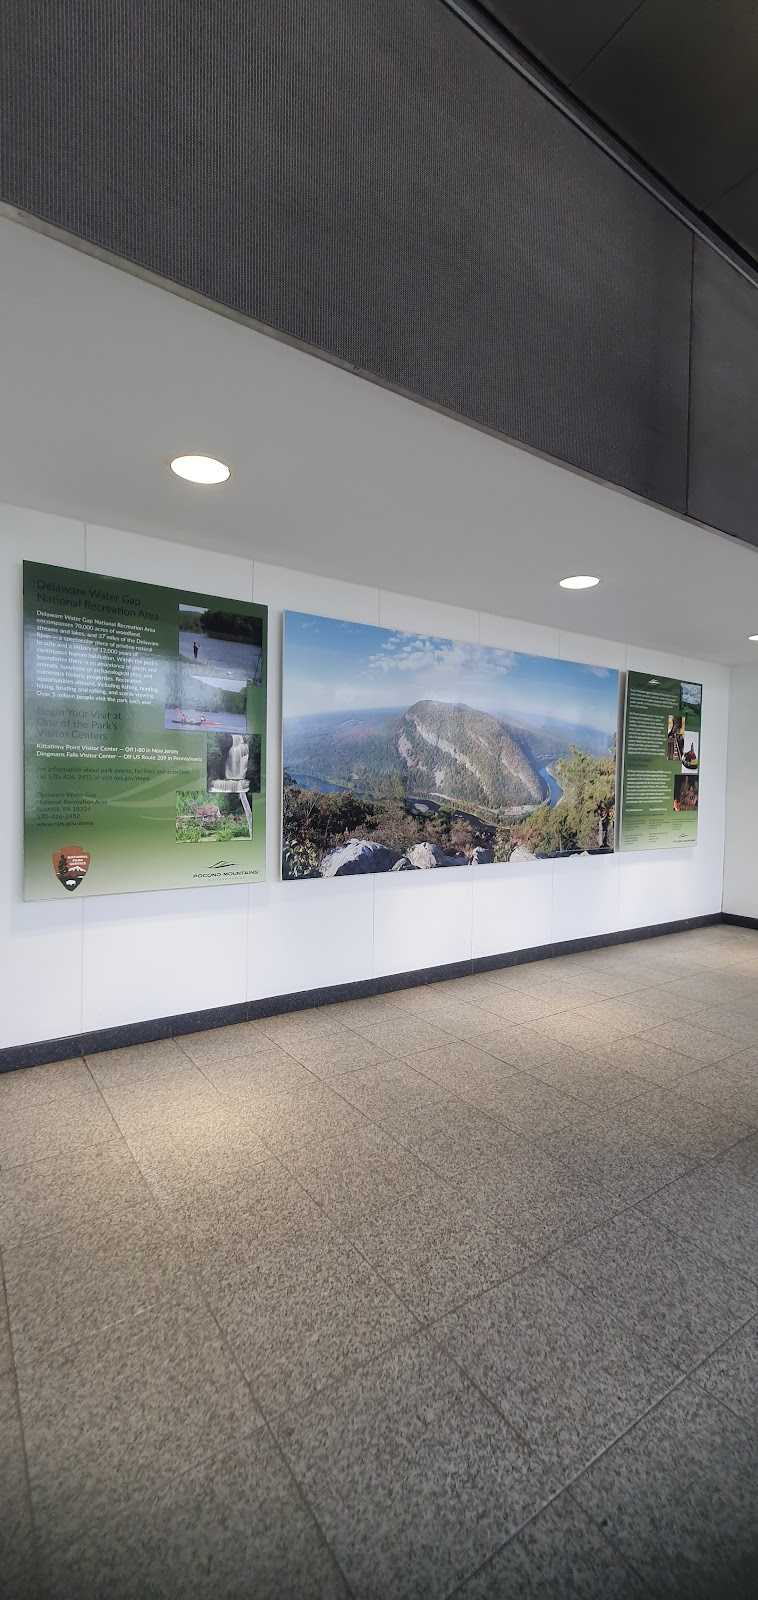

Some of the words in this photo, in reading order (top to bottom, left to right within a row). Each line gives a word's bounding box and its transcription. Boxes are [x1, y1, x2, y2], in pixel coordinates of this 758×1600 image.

[37, 580, 86, 596] Delaware
[90, 590, 119, 602] Water
[122, 595, 140, 606] Gap
[38, 592, 81, 608] National
[84, 600, 136, 616] Recreation
[138, 610, 159, 620] Area
[36, 610, 64, 620] Delaware
[94, 618, 116, 627] National
[117, 622, 144, 631] Recreation
[36, 618, 74, 628] encompasses
[74, 622, 94, 630] 70,000
[36, 640, 56, 648] beauty
[74, 644, 91, 652] history
[64, 636, 94, 645] spectacular
[136, 638, 160, 646] Delaware
[36, 648, 68, 656] continuous
[36, 654, 68, 663] boundaries
[98, 660, 125, 669] abundance
[36, 669, 65, 677] numerous
[60, 664, 86, 672] hundreds
[36, 676, 74, 685] opportunities
[98, 682, 120, 690] including
[56, 685, 77, 693] boating
[37, 706, 65, 718] Begin
[66, 708, 88, 718] Your
[90, 710, 110, 720] Visit
[36, 718, 58, 726] One
[60, 720, 70, 728] of
[73, 720, 88, 728] the
[91, 720, 118, 730] Park's
[36, 728, 68, 738] Visitor
[72, 730, 108, 740] Centers
